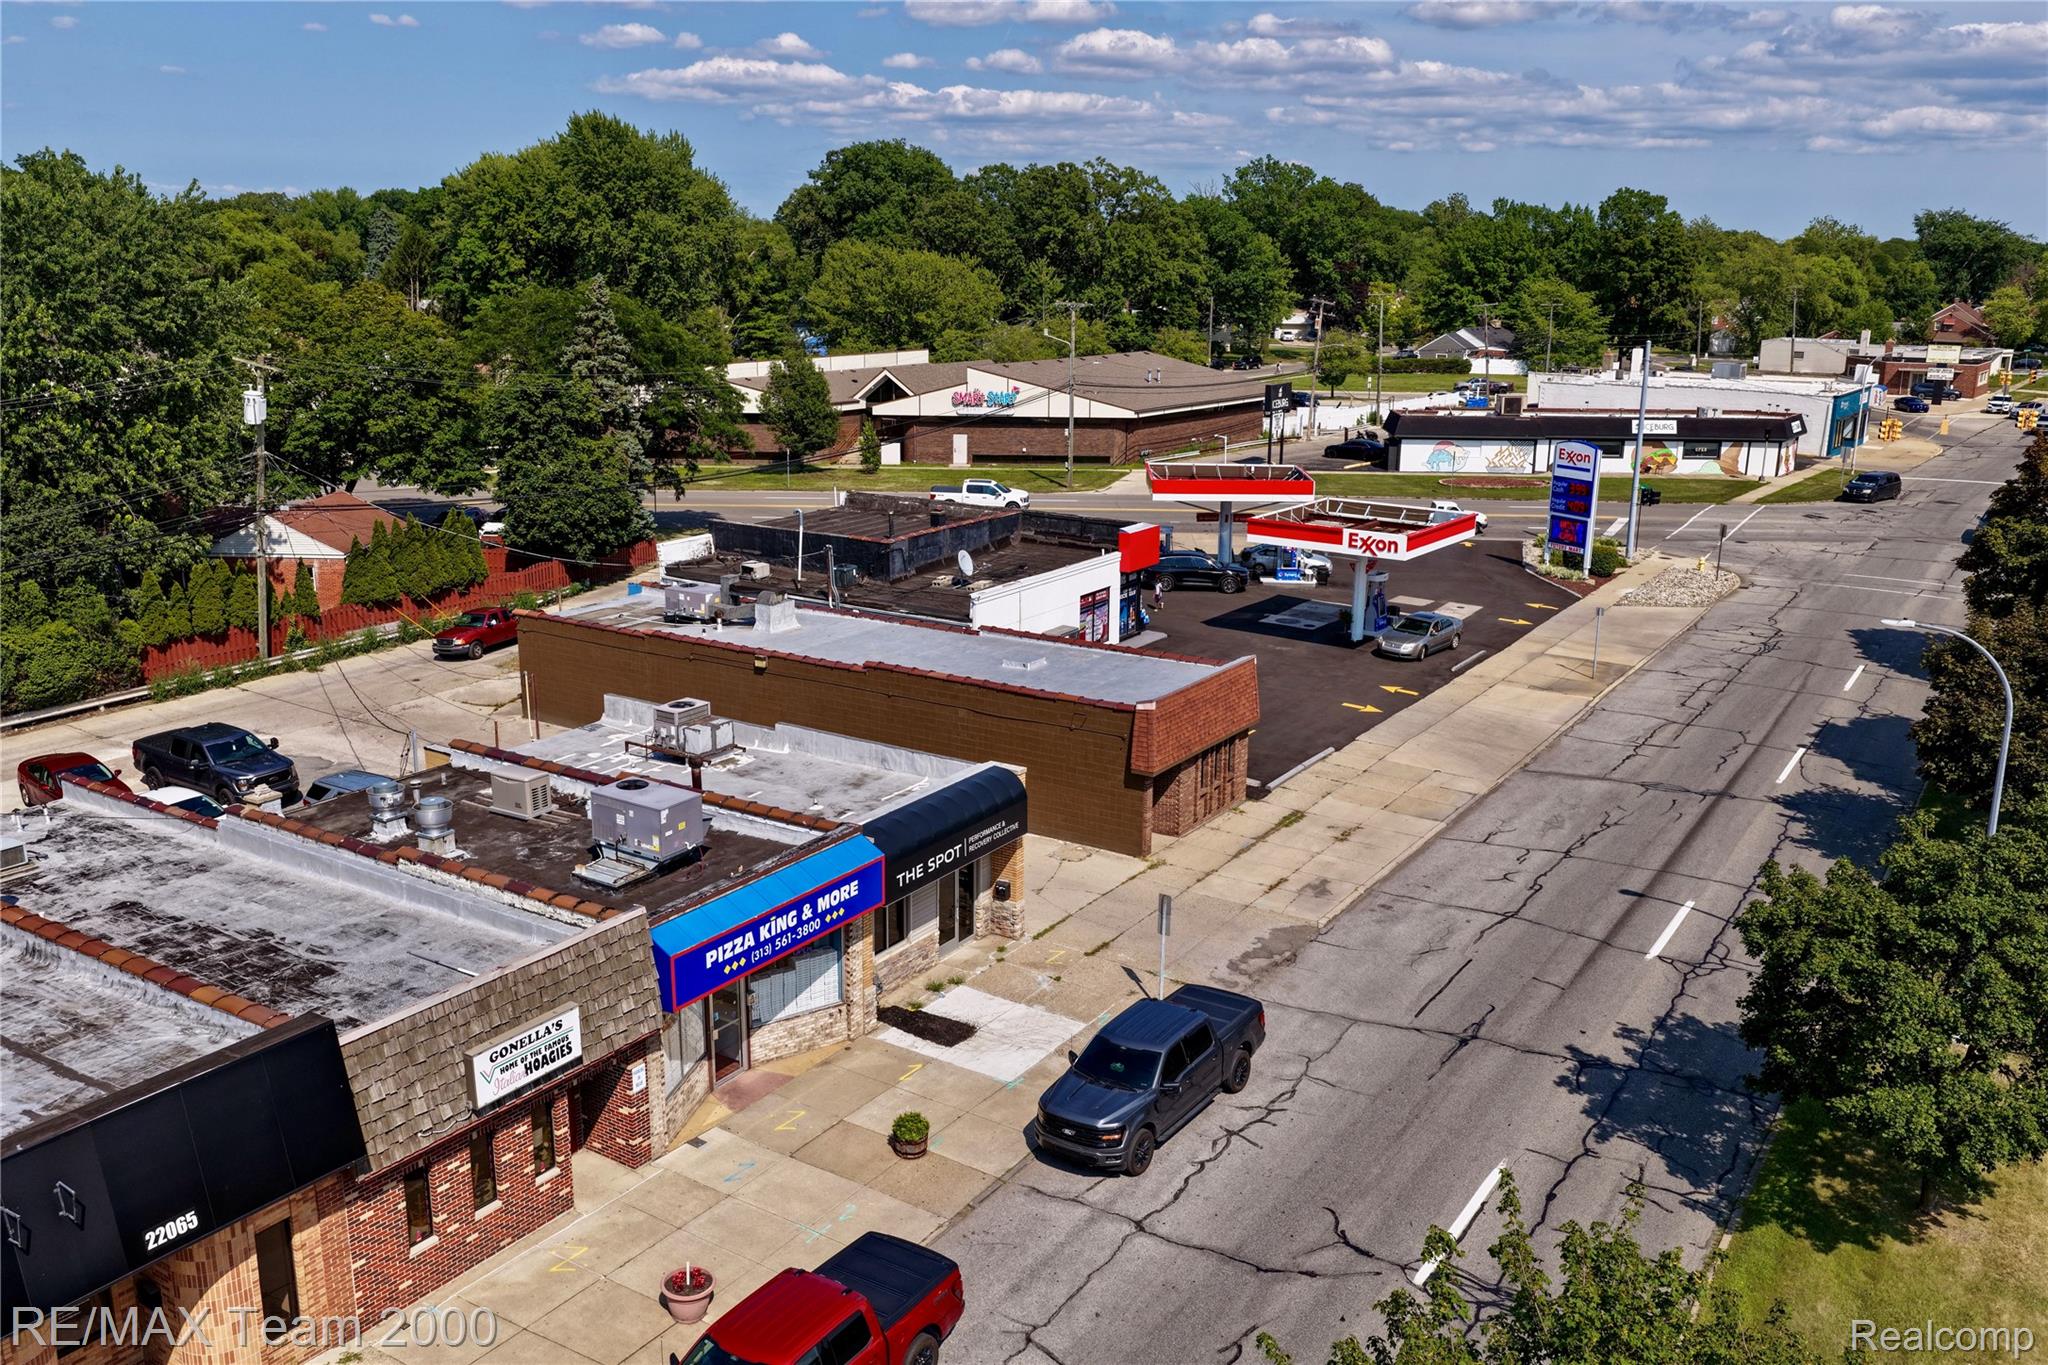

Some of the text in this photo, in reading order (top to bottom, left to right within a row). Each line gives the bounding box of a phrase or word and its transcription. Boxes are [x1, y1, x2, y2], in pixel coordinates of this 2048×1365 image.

[1558, 448, 1591, 466] Exxon
[1348, 532, 1398, 557] Exxon
[968, 822, 1001, 844] PERFORMANCE
[968, 821, 1019, 853] RECOVERY COLLECTIVE
[896, 844, 962, 887] THE SPOT
[705, 931, 755, 969] PIZZA
[801, 903, 813, 920] &
[817, 880, 859, 913] MORE
[751, 919, 821, 963] (313) 561-3800
[489, 1019, 563, 1063] GONELLA'S
[499, 1034, 570, 1075] HOME OF THE FAMOUS
[524, 1041, 573, 1076] HOAGIES
[145, 1210, 199, 1250] 22065
